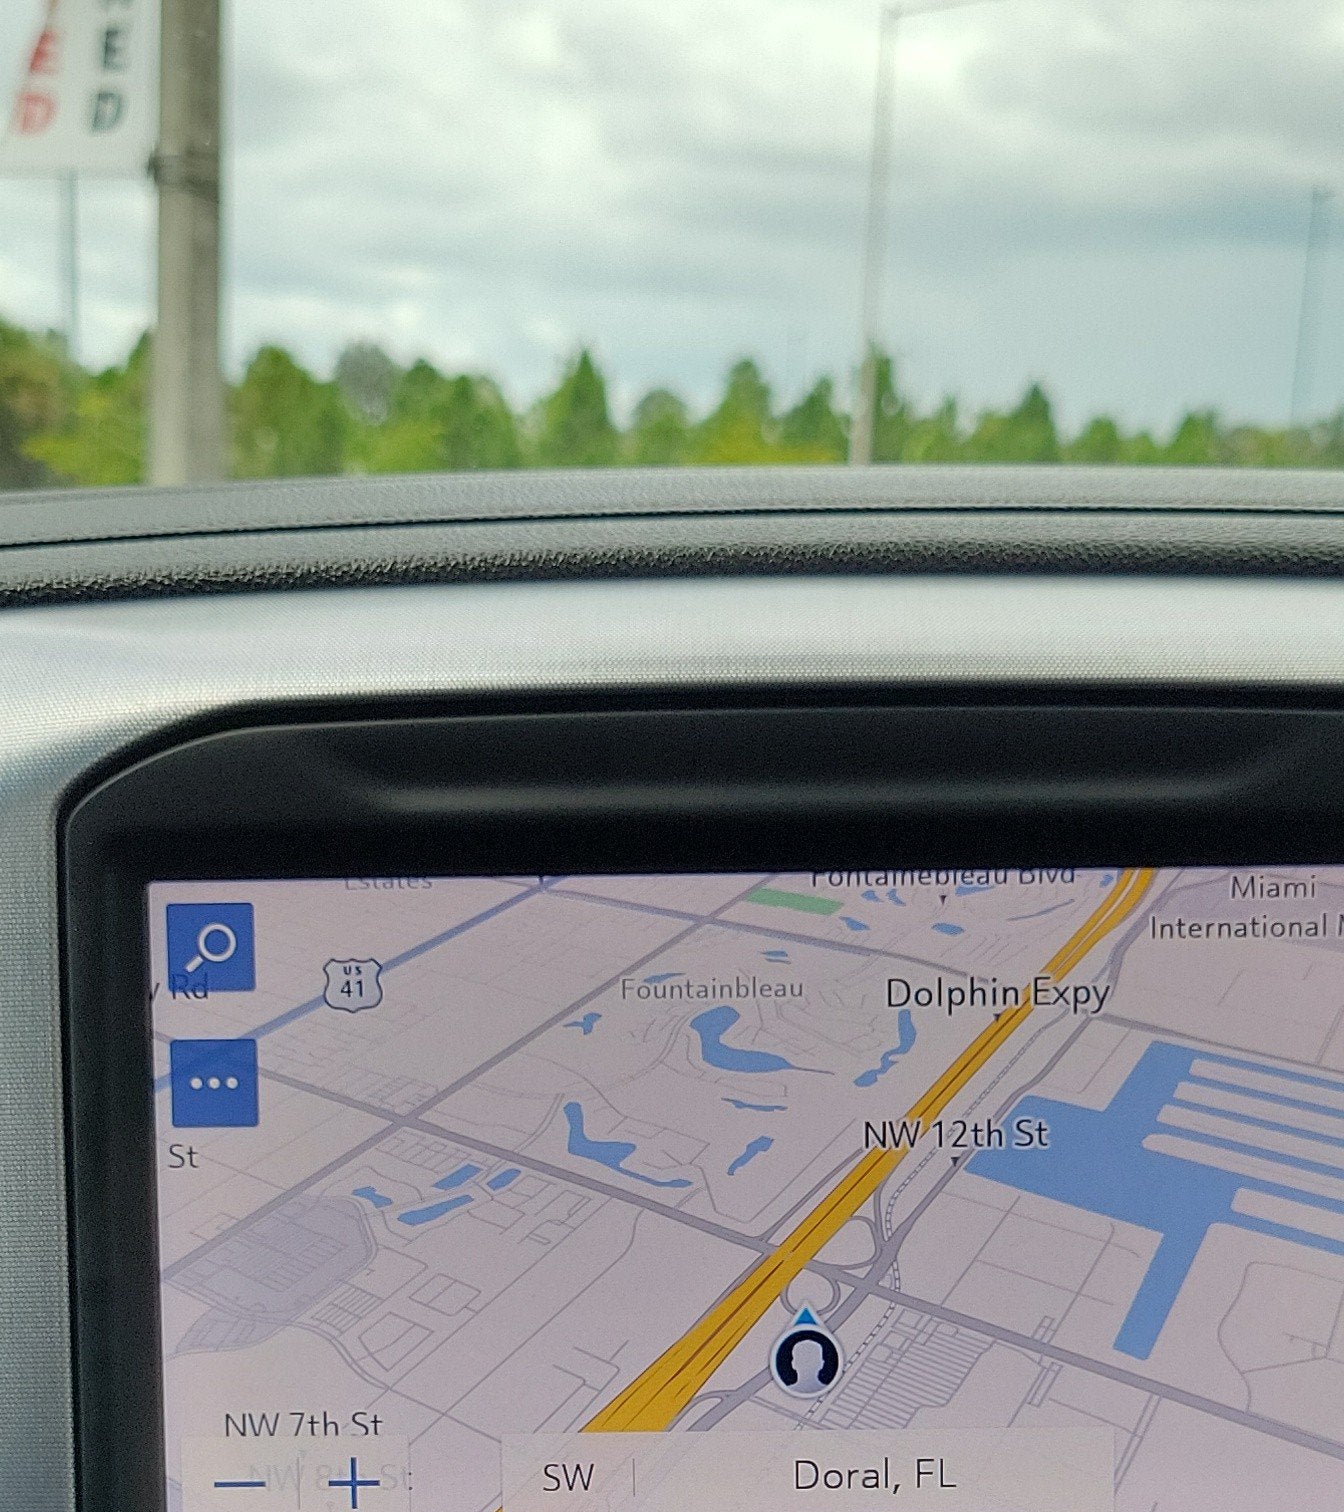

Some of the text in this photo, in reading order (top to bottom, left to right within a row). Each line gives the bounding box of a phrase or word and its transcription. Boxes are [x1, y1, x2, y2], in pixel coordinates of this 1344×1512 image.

[1229, 875, 1317, 900] Miami
[1150, 914, 1328, 941] International
[342, 965, 363, 977] US
[340, 981, 365, 998] 41
[621, 977, 805, 1001] Fountainbleau
[886, 976, 1111, 1016] Dolphin Expy
[863, 1119, 1050, 1149] NW 12th St
[167, 1144, 199, 1169] St
[224, 1411, 384, 1437] NW 7th St
[542, 1462, 595, 1492] SW
[793, 1456, 958, 1495] Doral, FL
